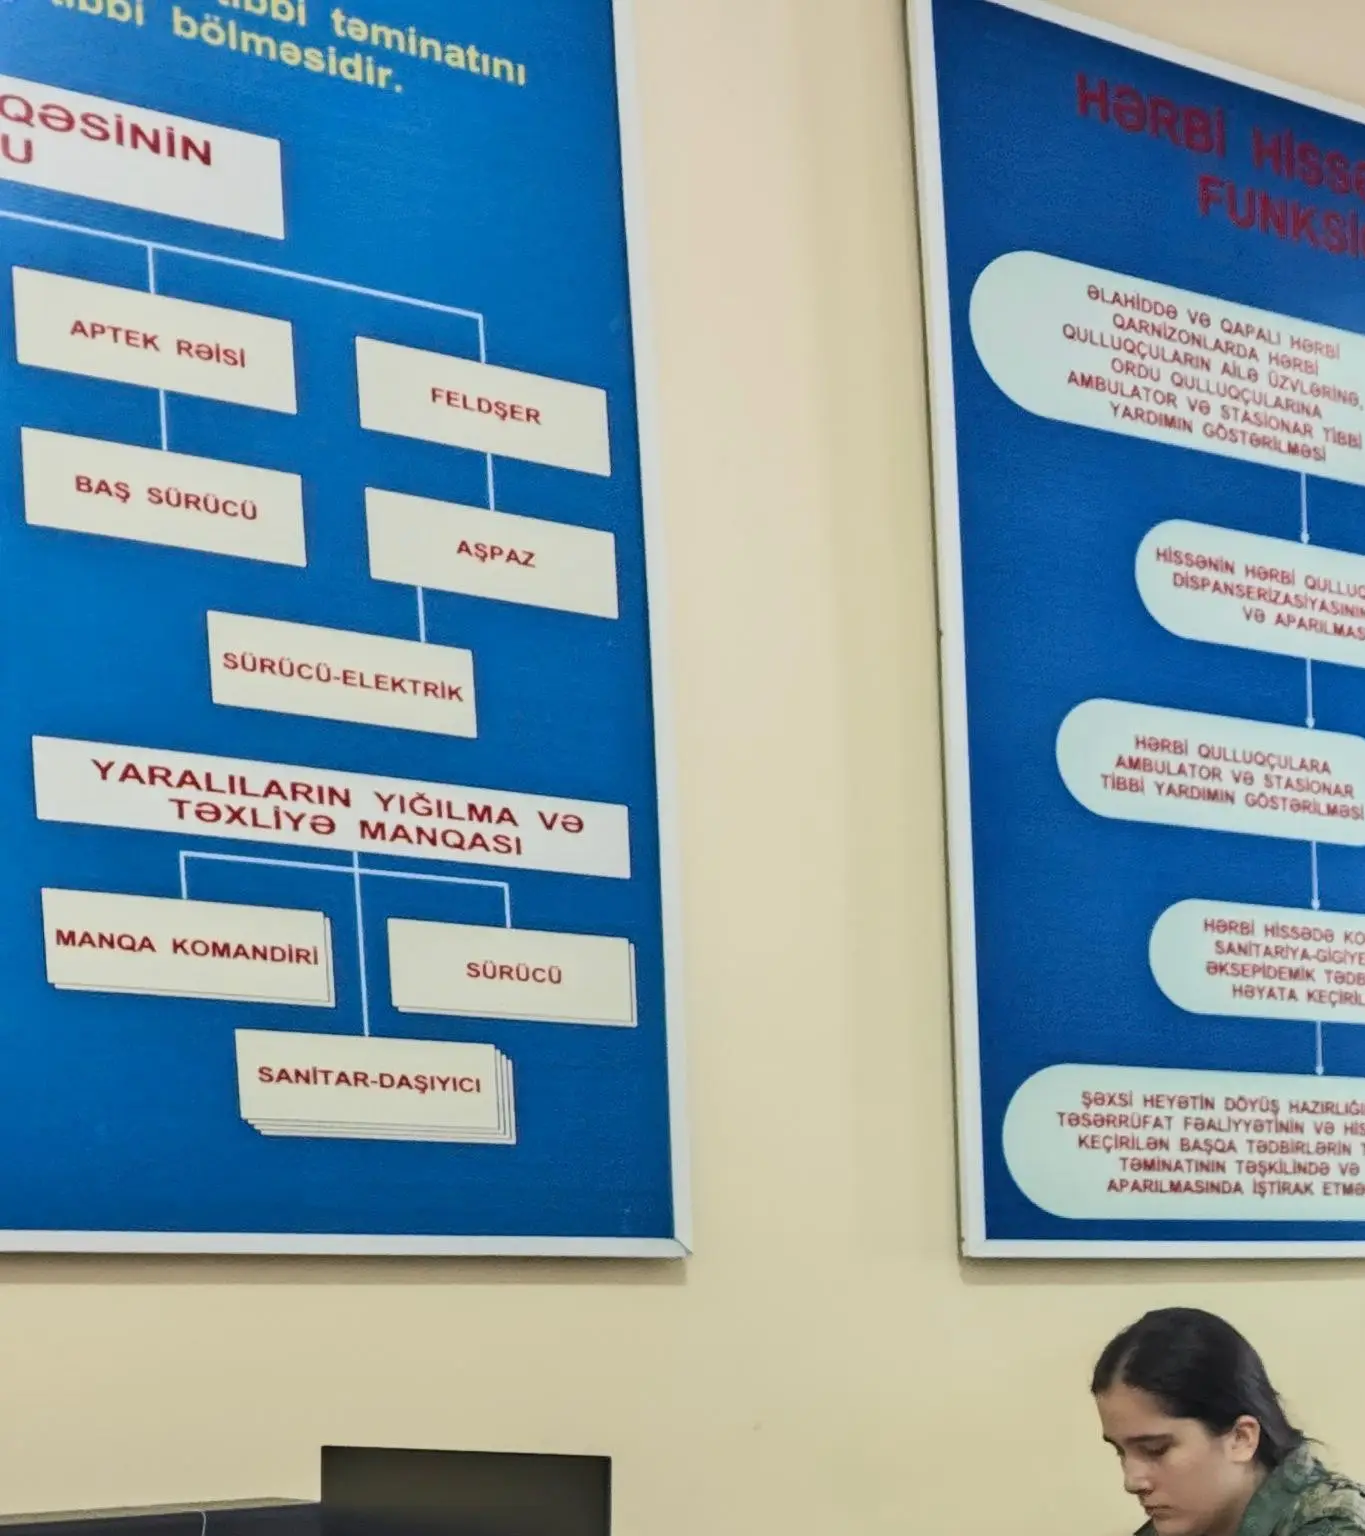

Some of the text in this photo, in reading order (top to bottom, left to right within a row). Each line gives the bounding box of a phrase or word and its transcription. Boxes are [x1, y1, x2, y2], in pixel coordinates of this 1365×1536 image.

[172, 6, 403, 93] bölməsidir.
[330, 7, 526, 86] təminatını
[1076, 72, 1226, 158] HƏRBİ
[1086, 286, 1340, 359] ƏLAHİDDƏ VƏ QAPALI HƏRBİ
[69, 319, 247, 369] APTEK RƏİSİ
[1061, 322, 1210, 372] QULLUQÇULARIN
[1220, 361, 1258, 383] AİLƏ
[1112, 313, 1318, 375] QARNİZONLARDA HƏRBİ
[430, 387, 542, 427] FELDŞER
[1110, 358, 1322, 418] ORDU QULLUQÇULARINA
[1066, 371, 1362, 449] AMBULATOR VƏ STASİONAR TİBBİ
[1109, 402, 1326, 462] YARDIMIN GÖSTƏRİLMƏSİ
[75, 474, 258, 522] BAŞ SÜRÜCÜ
[455, 540, 536, 570] AŞPAZ
[1155, 546, 1235, 575] HİSSƏNİN
[1244, 564, 1295, 586] HƏRBİ
[1242, 606, 1265, 623] VƏ
[222, 651, 464, 702] SÜRÜCÜ-ELEKTRİK
[1134, 735, 1331, 775] HƏRBİ QULLUQÇULARA
[91, 757, 586, 834] YARALILARIN YIĞILMA VƏ
[1100, 773, 1364, 820] TİBBİ YARDIMIN GÖSTƏRİLMƏSİ
[1114, 755, 1354, 799] AMBULATOR VƏ STASİONAR
[168, 797, 523, 857] TƏXLİYƏ MANQASI
[55, 928, 320, 967] MANQA KOMANDİRİ
[1203, 919, 1254, 935] HƏRBİ
[1264, 922, 1334, 943] HİSSƏDƏ
[465, 957, 563, 985] SÜRÜCÜ
[1205, 961, 1316, 982] ƏKSEPİDEMİK
[1231, 983, 1297, 1001] HƏYATA
[257, 1064, 482, 1095] SANİTAR-DAŞIYICI
[1055, 1111, 1173, 1129] TƏSƏRRÜFAT
[1183, 1114, 1304, 1133] FƏALİYYƏTİNİN
[1313, 1121, 1335, 1134] VƏ
[1081, 1090, 1133, 1108] ŞƏXSİ
[1143, 1093, 1215, 1110] HEYƏTİN
[1223, 1095, 1279, 1115] DÖYÜŞ
[1077, 1132, 1169, 1152] KEÇİRİLƏN
[1180, 1138, 1237, 1154] BAŞQA
[1246, 1138, 1351, 1155] TƏDBİRLƏRİN
[1119, 1155, 1359, 1177] TƏMİNATININ TƏŞKİLİNDƏ VƏ
[1107, 1178, 1244, 1194] APARILMASINDA
[1253, 1178, 1313, 1197] İŞTİRAK
